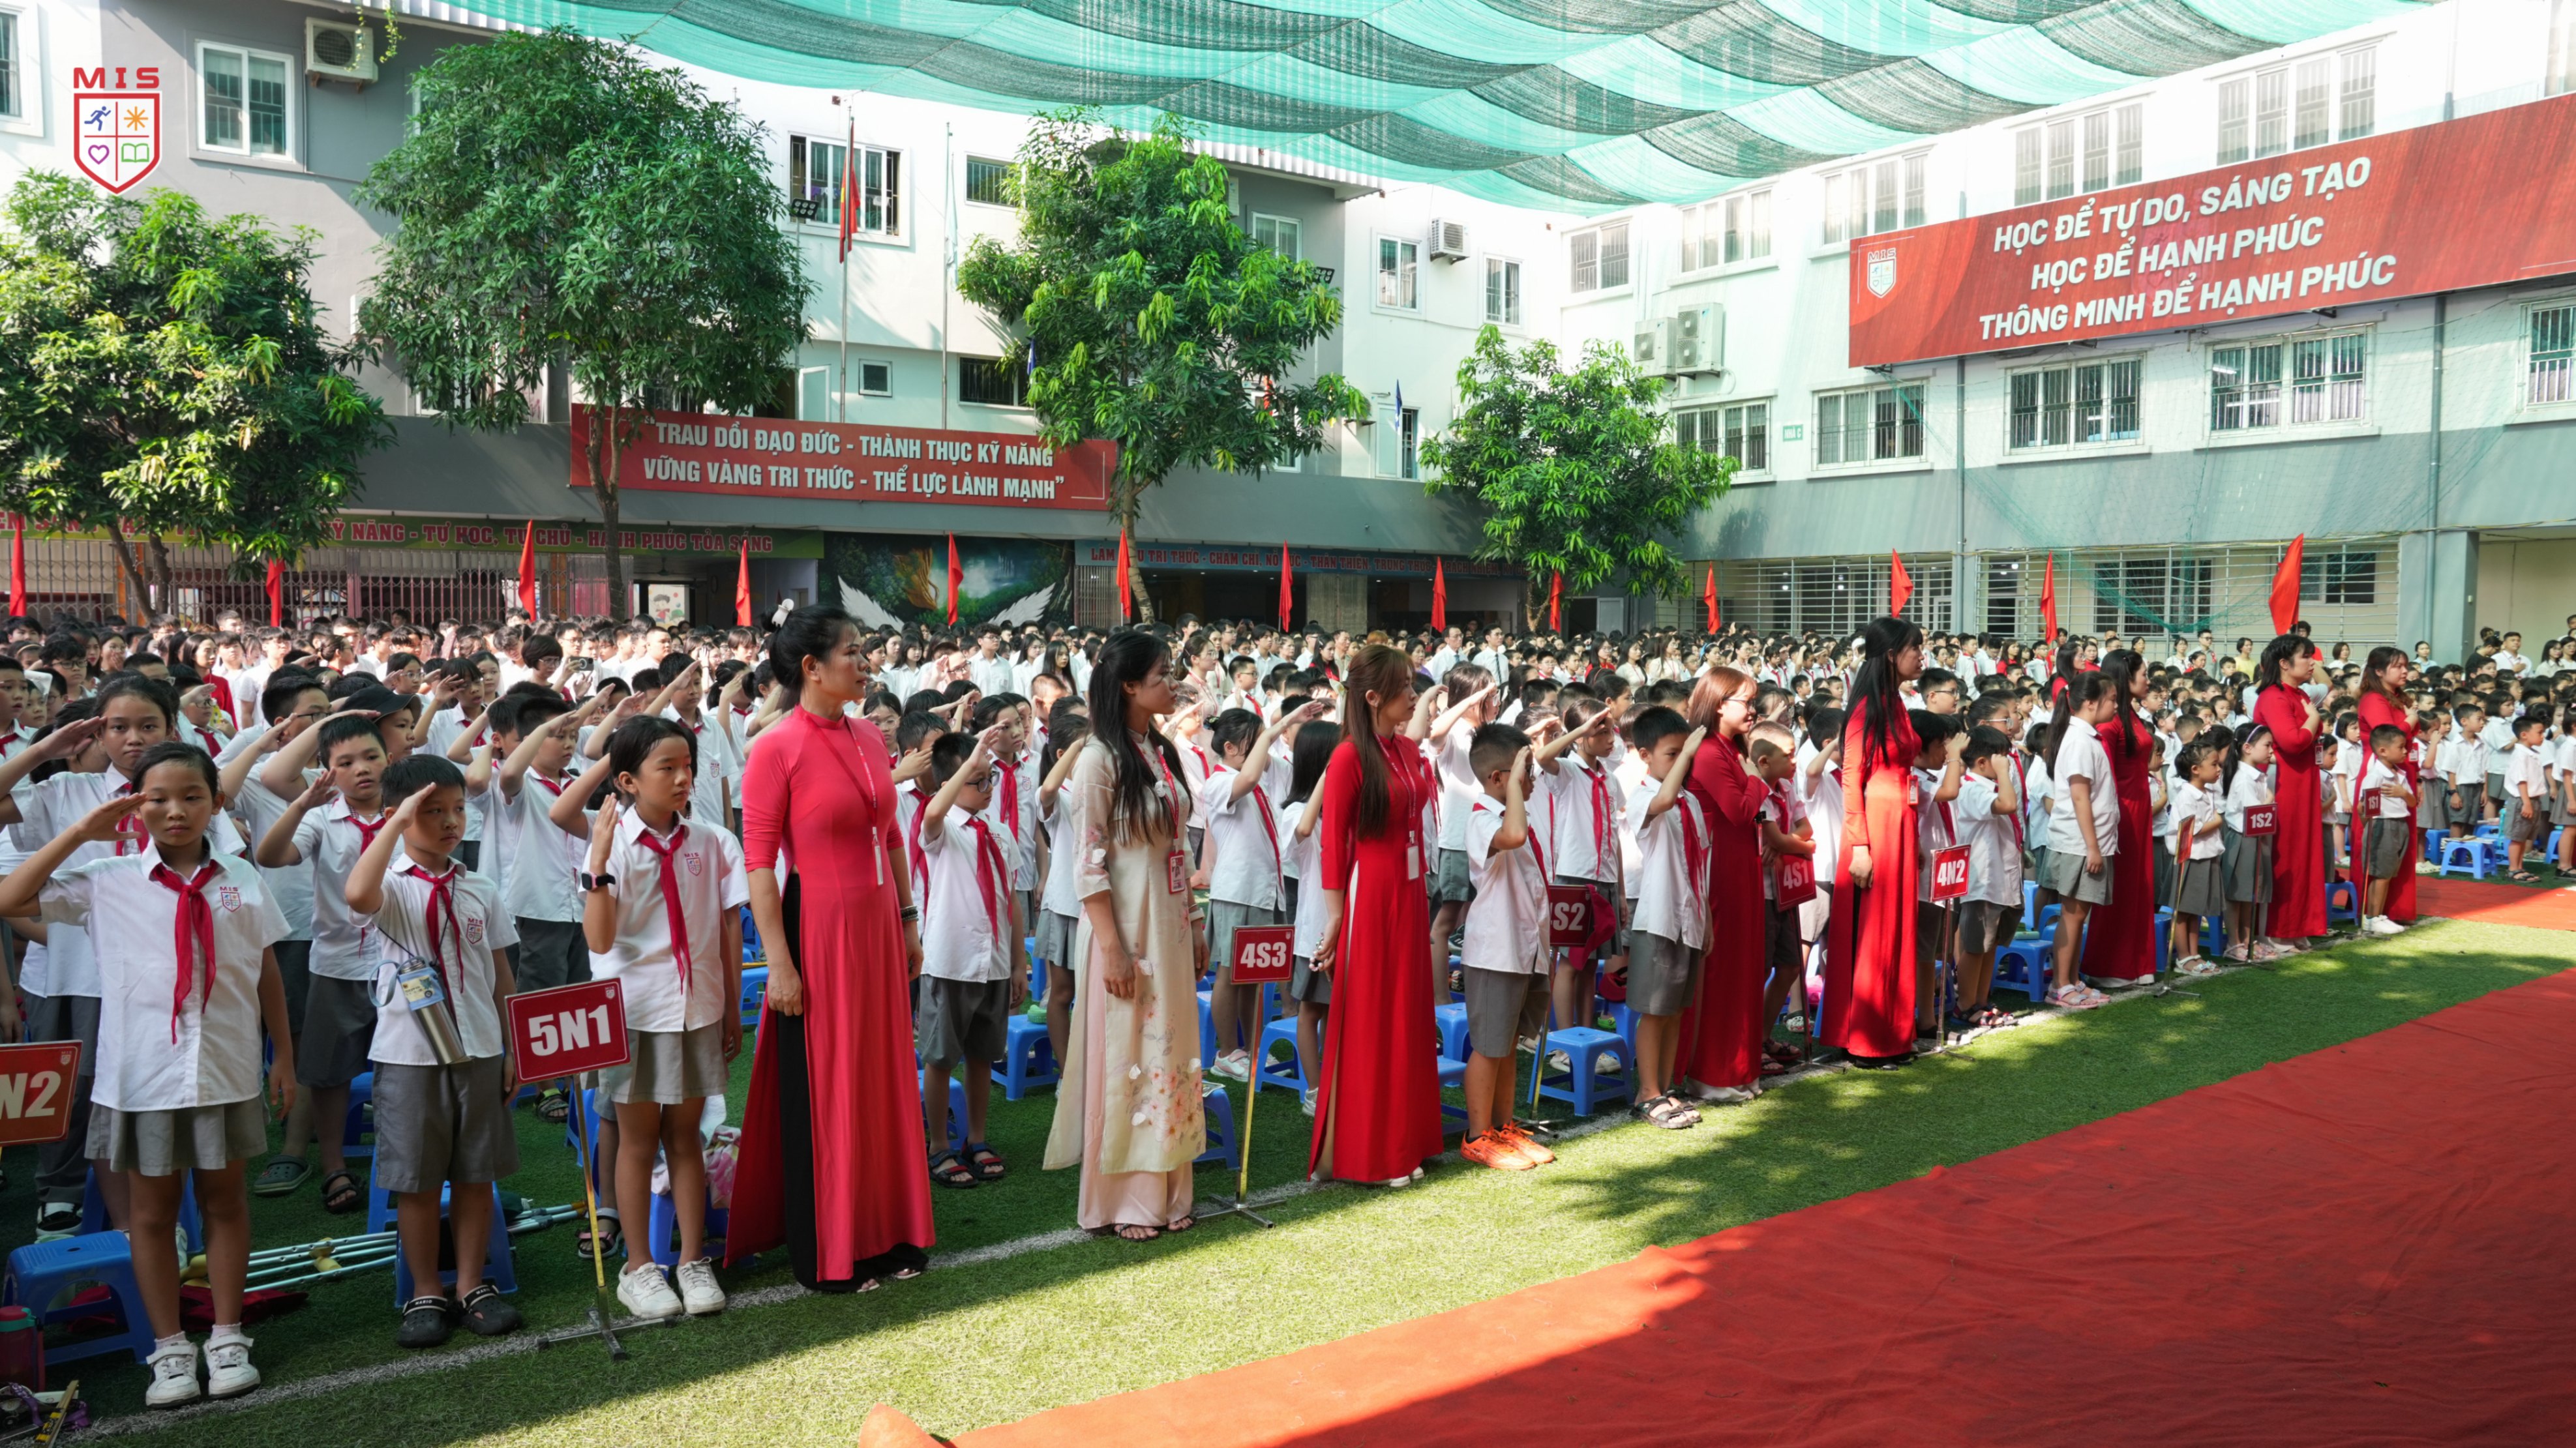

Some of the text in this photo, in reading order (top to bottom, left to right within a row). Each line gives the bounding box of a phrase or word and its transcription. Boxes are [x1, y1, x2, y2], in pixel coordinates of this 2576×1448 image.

[1994, 156, 2371, 256] HỌC ĐỂ TỰ DO, SÁNG TẠO
[1867, 248, 1896, 261] MIS
[2031, 214, 2324, 293] HỌC ĐỂ HẠNH PHÚC
[1979, 251, 2397, 340] THÔNG MINH ĐỂ HẠNH PHÚC
[715, 421, 748, 449] DỒI
[755, 429, 795, 456] ĐẠO
[801, 429, 841, 454] ĐỨC
[860, 434, 921, 459] THÀNH
[926, 440, 972, 465] THỤC
[978, 441, 1000, 464] KỸ
[1006, 442, 1053, 467] NĂNG
[1797, 428, 1801, 438] C
[643, 454, 700, 482] VỮNG
[707, 458, 762, 486] VÀNG
[768, 465, 798, 487] TRI
[805, 465, 854, 490] THỨC
[873, 464, 908, 492] THỂ
[913, 472, 946, 497] LỰC
[952, 472, 998, 497] LÀNH
[351, 519, 405, 542] NĂNG
[423, 521, 451, 548] TỰ
[535, 523, 572, 546] CHỦ
[640, 528, 687, 550] PHÚC
[691, 528, 725, 552] TỎA
[1148, 550, 1168, 563] TRI
[1171, 547, 1200, 565] THỨC
[1374, 558, 1405, 571] TRUNG
[2368, 795, 2378, 809] 1S1
[2250, 812, 2273, 828] 1S2
[1784, 860, 1809, 889] 4S1
[1937, 859, 1966, 886] 4N2
[1550, 902, 1585, 931] S2
[1240, 941, 1287, 968] 4S3
[528, 1004, 611, 1056] 5N1
